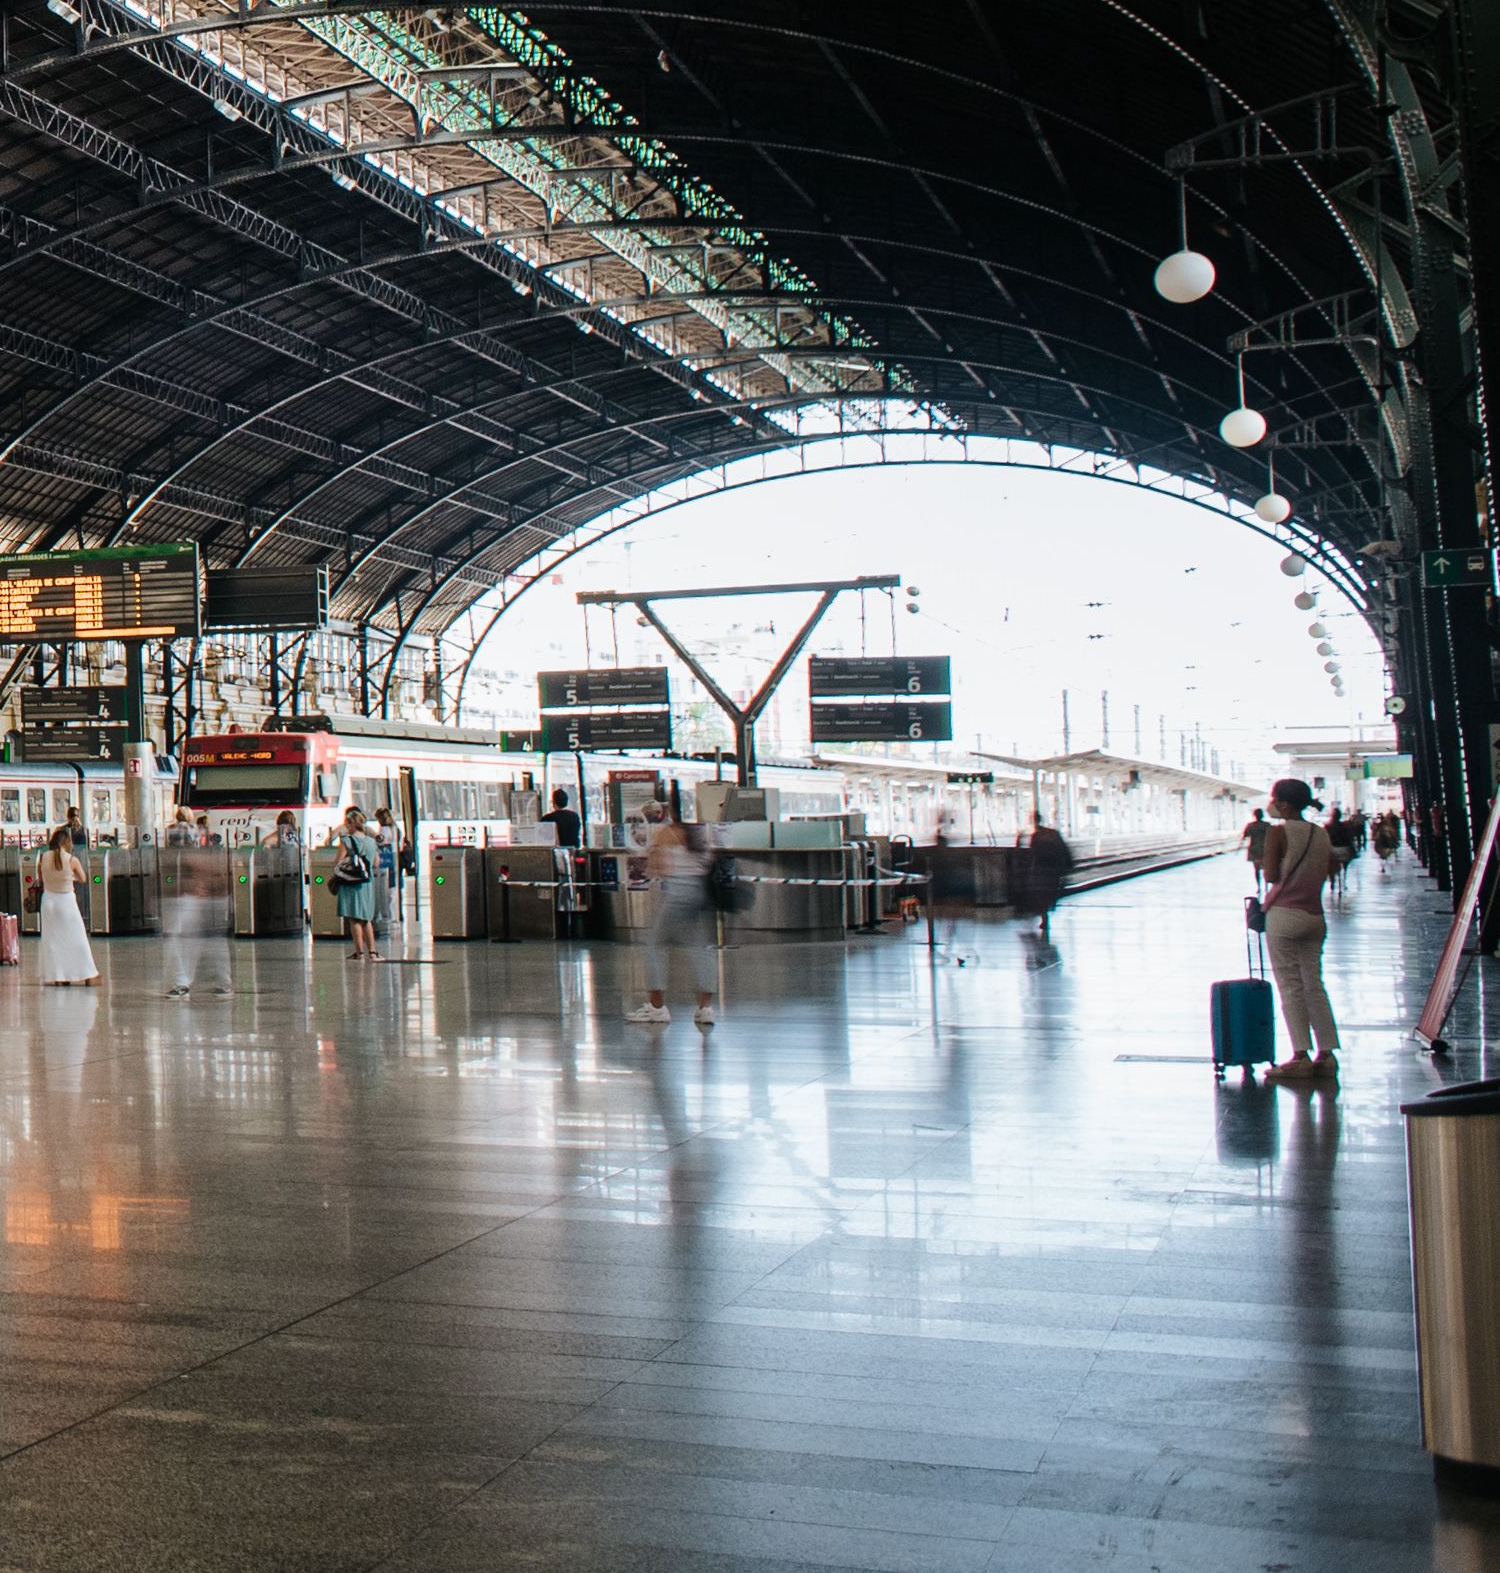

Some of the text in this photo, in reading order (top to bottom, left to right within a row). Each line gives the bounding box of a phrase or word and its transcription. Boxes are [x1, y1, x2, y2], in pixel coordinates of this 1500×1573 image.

[907, 676, 921, 693] 6
[566, 690, 578, 705] 5
[99, 704, 110, 718] 4
[909, 722, 922, 739] 6
[568, 734, 580, 749] 5
[100, 744, 112, 759] 4
[186, 754, 215, 763] 005M
[220, 814, 257, 828] renf
